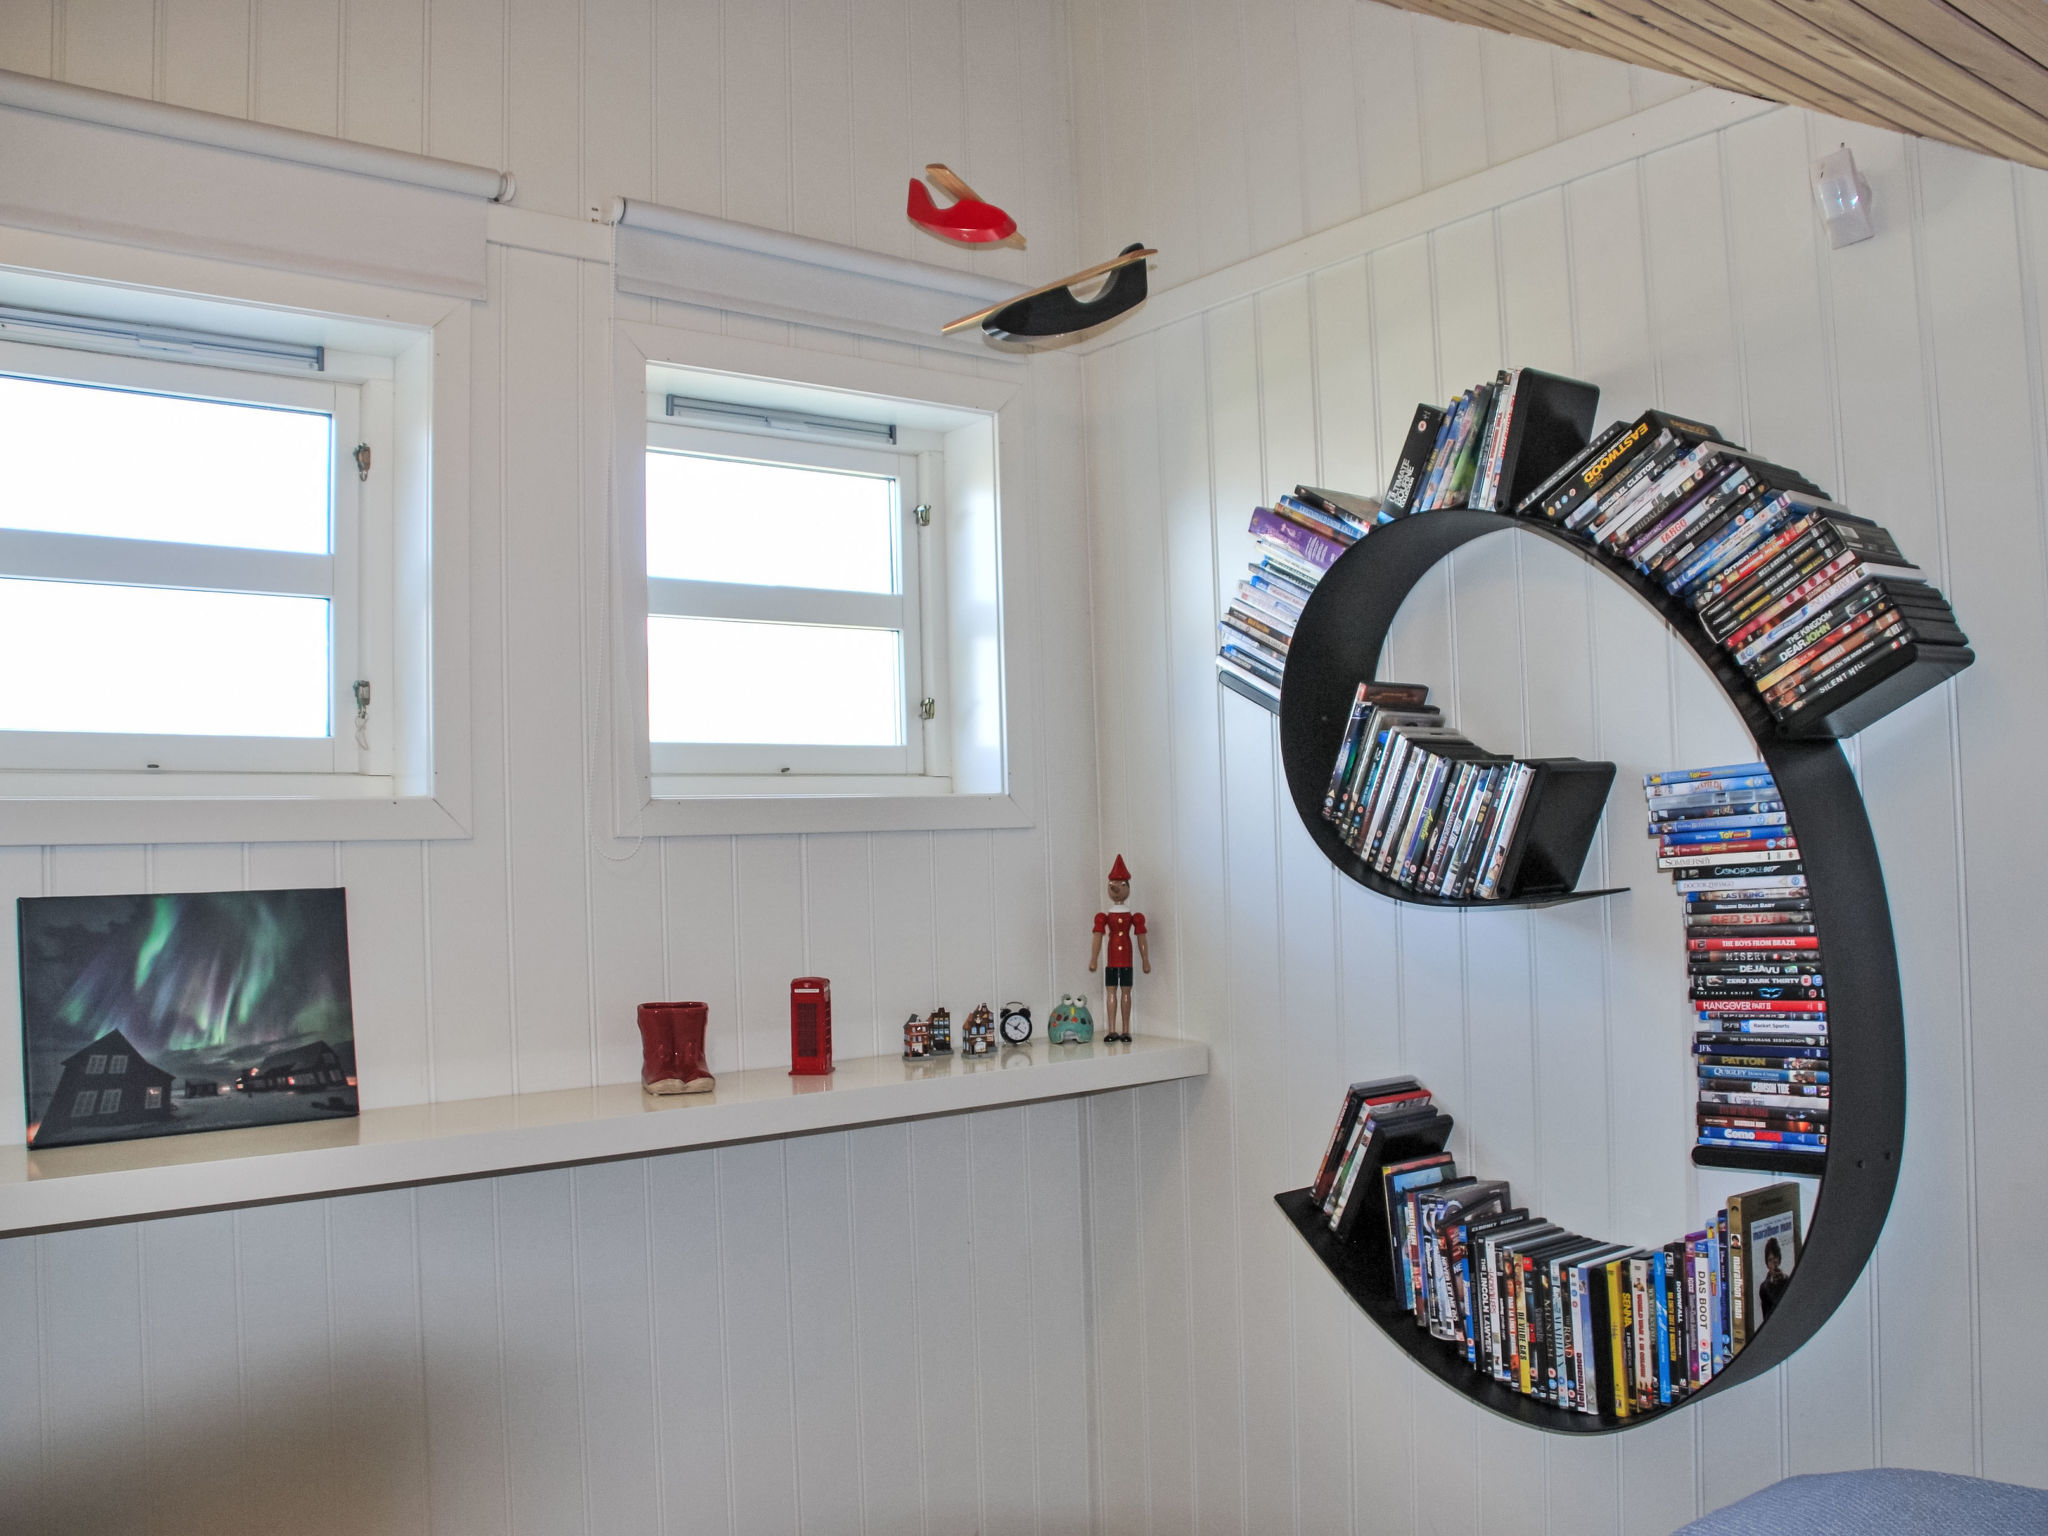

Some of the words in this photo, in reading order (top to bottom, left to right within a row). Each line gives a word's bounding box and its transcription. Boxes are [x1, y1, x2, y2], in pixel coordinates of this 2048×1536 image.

[1581, 423, 1649, 482] EASTWOOD
[1388, 457, 1411, 502] ULTIMATE
[1393, 464, 1415, 505] BOURNE
[1598, 486, 1628, 511] MICHAEL
[1625, 460, 1656, 487] CLAYTON
[1632, 500, 1670, 531] HIDALGO
[1659, 518, 1687, 542] FARGO
[1699, 517, 1710, 527] JOE
[1708, 504, 1725, 519] BLACK
[1778, 638, 1807, 661] DEAR
[1803, 622, 1831, 644] JOHN
[1786, 632, 1801, 644] THE
[1798, 610, 1833, 635] KINGDOM
[1818, 672, 1848, 693] SILENT
[1847, 660, 1867, 676] HILL
[1718, 830, 1734, 839] TOY
[1665, 856, 1712, 866] SOMMERSBY
[1710, 914, 1740, 924] RED
[1725, 952, 1767, 961] MISERY
[1703, 1001, 1751, 1010] HANGOVER
[1751, 1002, 1766, 1010] PART
[1699, 1044, 1712, 1052] JFK
[1721, 1057, 1766, 1066] PATTON
[1713, 1067, 1747, 1076] QUIGLEY
[1440, 1256, 1450, 1281] NEVER
[1445, 1281, 1453, 1296] LET
[1481, 1271, 1490, 1313] LINCOLN
[1697, 1270, 1706, 1294] DAS
[1732, 1256, 1742, 1298] marathon
[1517, 1311, 1525, 1321] DE
[1621, 1291, 1632, 1327] SENNA
[1675, 1280, 1683, 1323] DOWNFALL
[1698, 1296, 1707, 1330] BOOT
[1733, 1299, 1742, 1319] man
[1484, 1315, 1493, 1353] LAWYER
[1517, 1322, 1527, 1343] VILDE
[1543, 1299, 1554, 1358] MUNICH
[1564, 1325, 1574, 1358] ROAD
